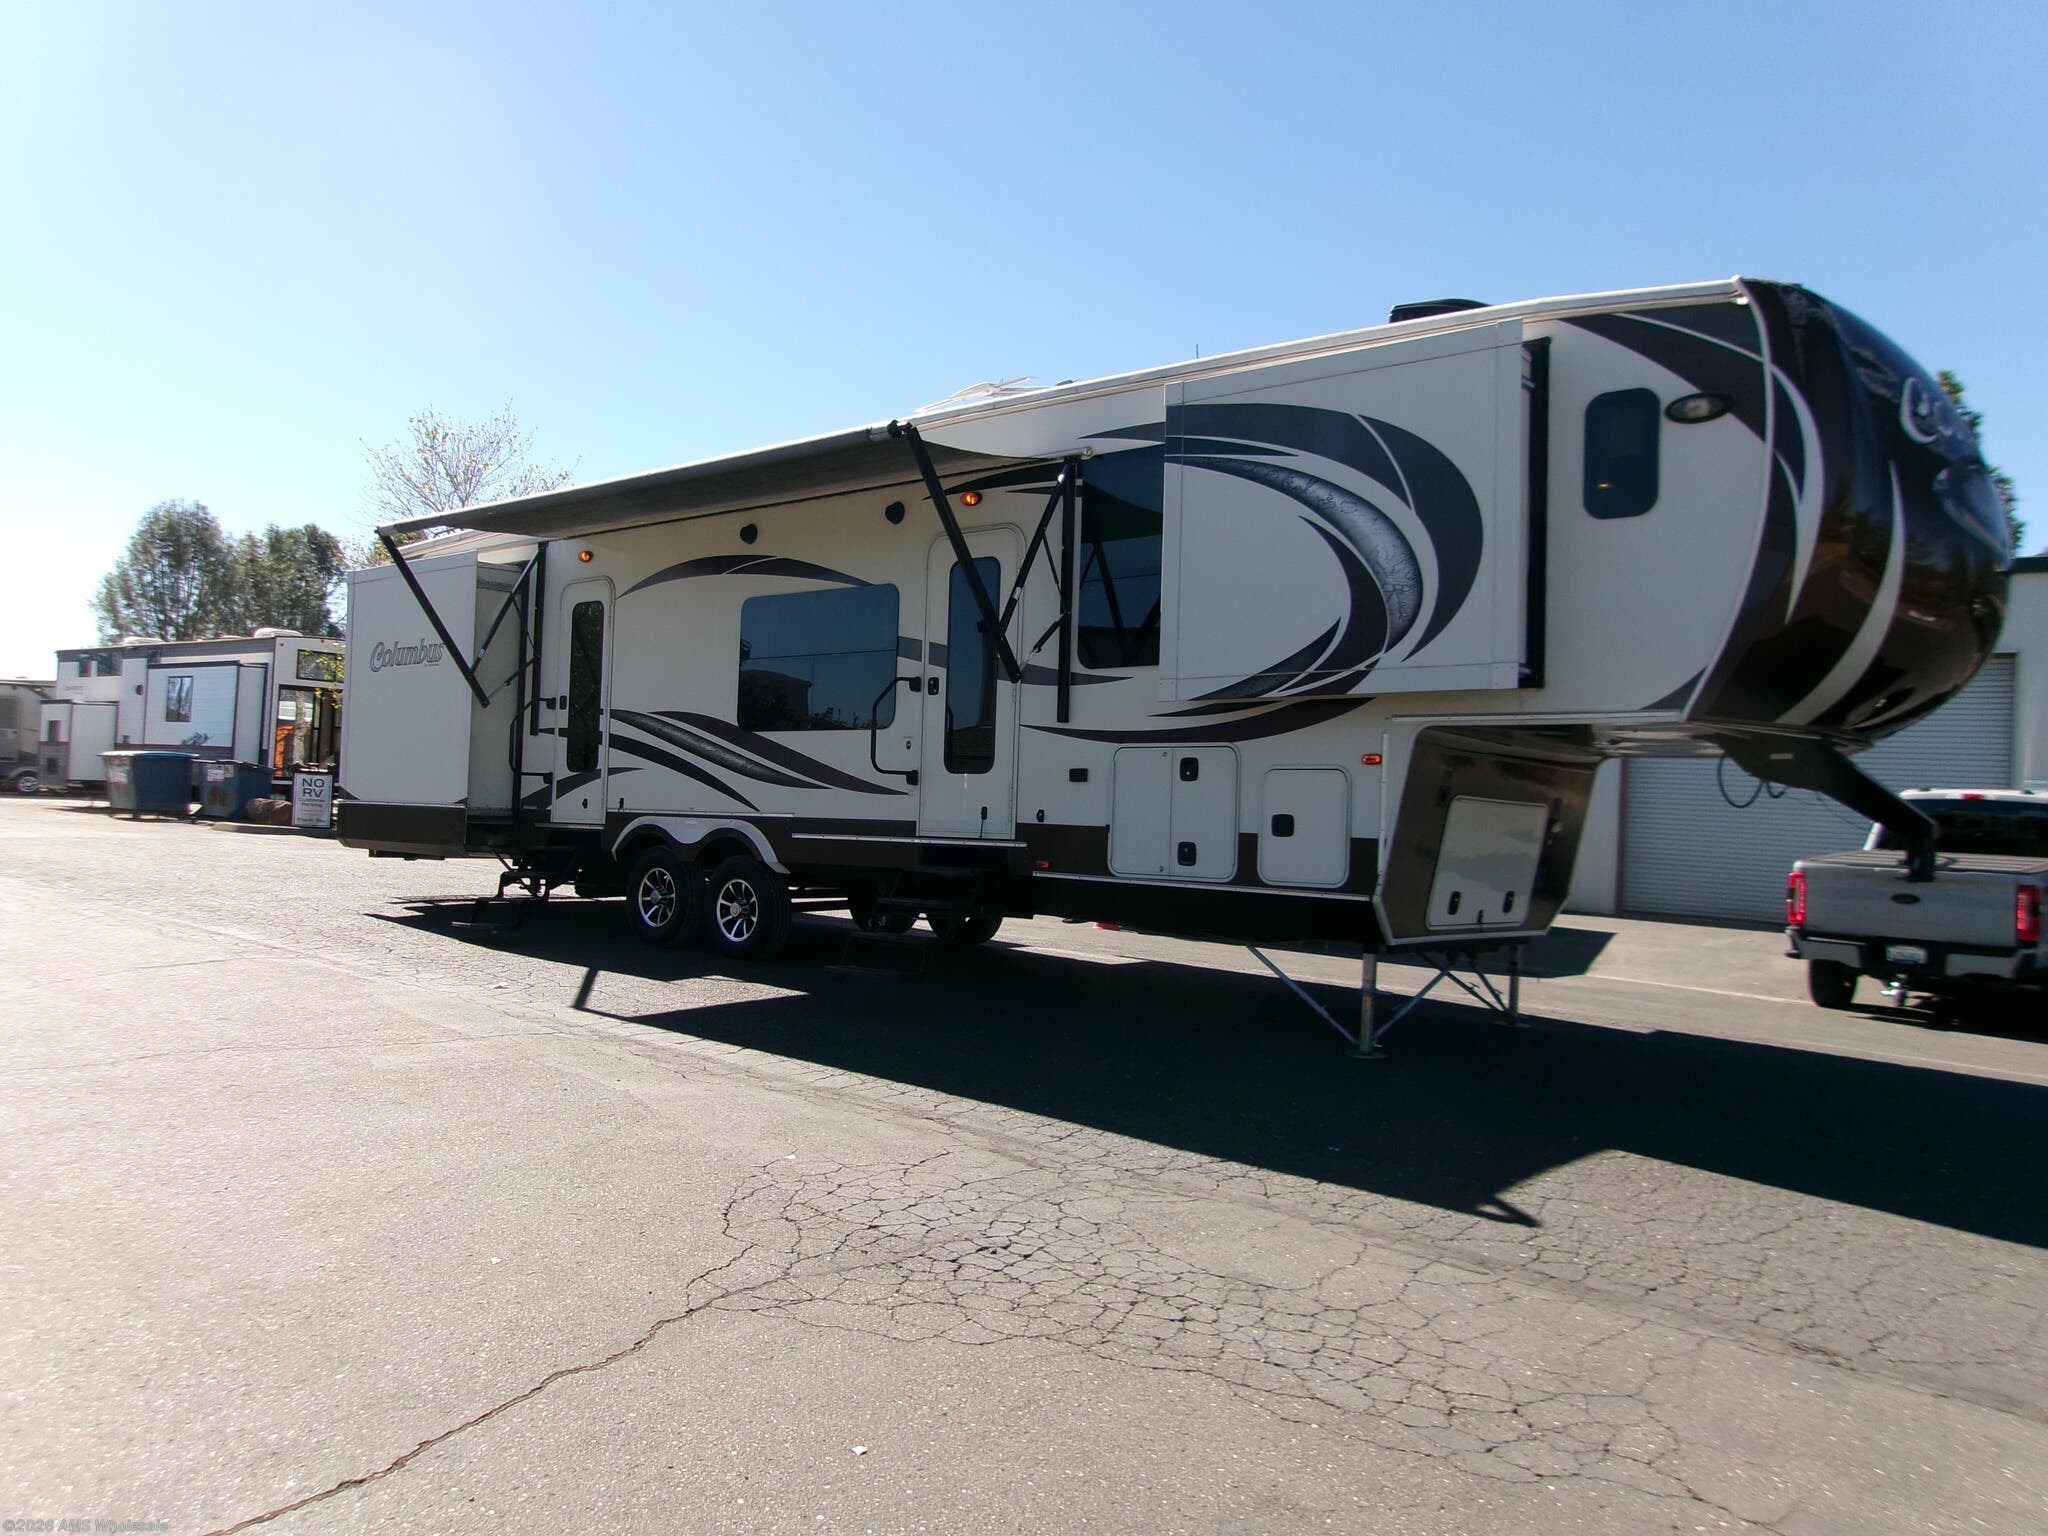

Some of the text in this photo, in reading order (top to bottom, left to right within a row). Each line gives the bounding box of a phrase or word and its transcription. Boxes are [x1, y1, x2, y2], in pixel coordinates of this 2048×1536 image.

[370, 637, 445, 672] Columbus
[302, 778, 325, 788] NO
[302, 788, 324, 798] RV
